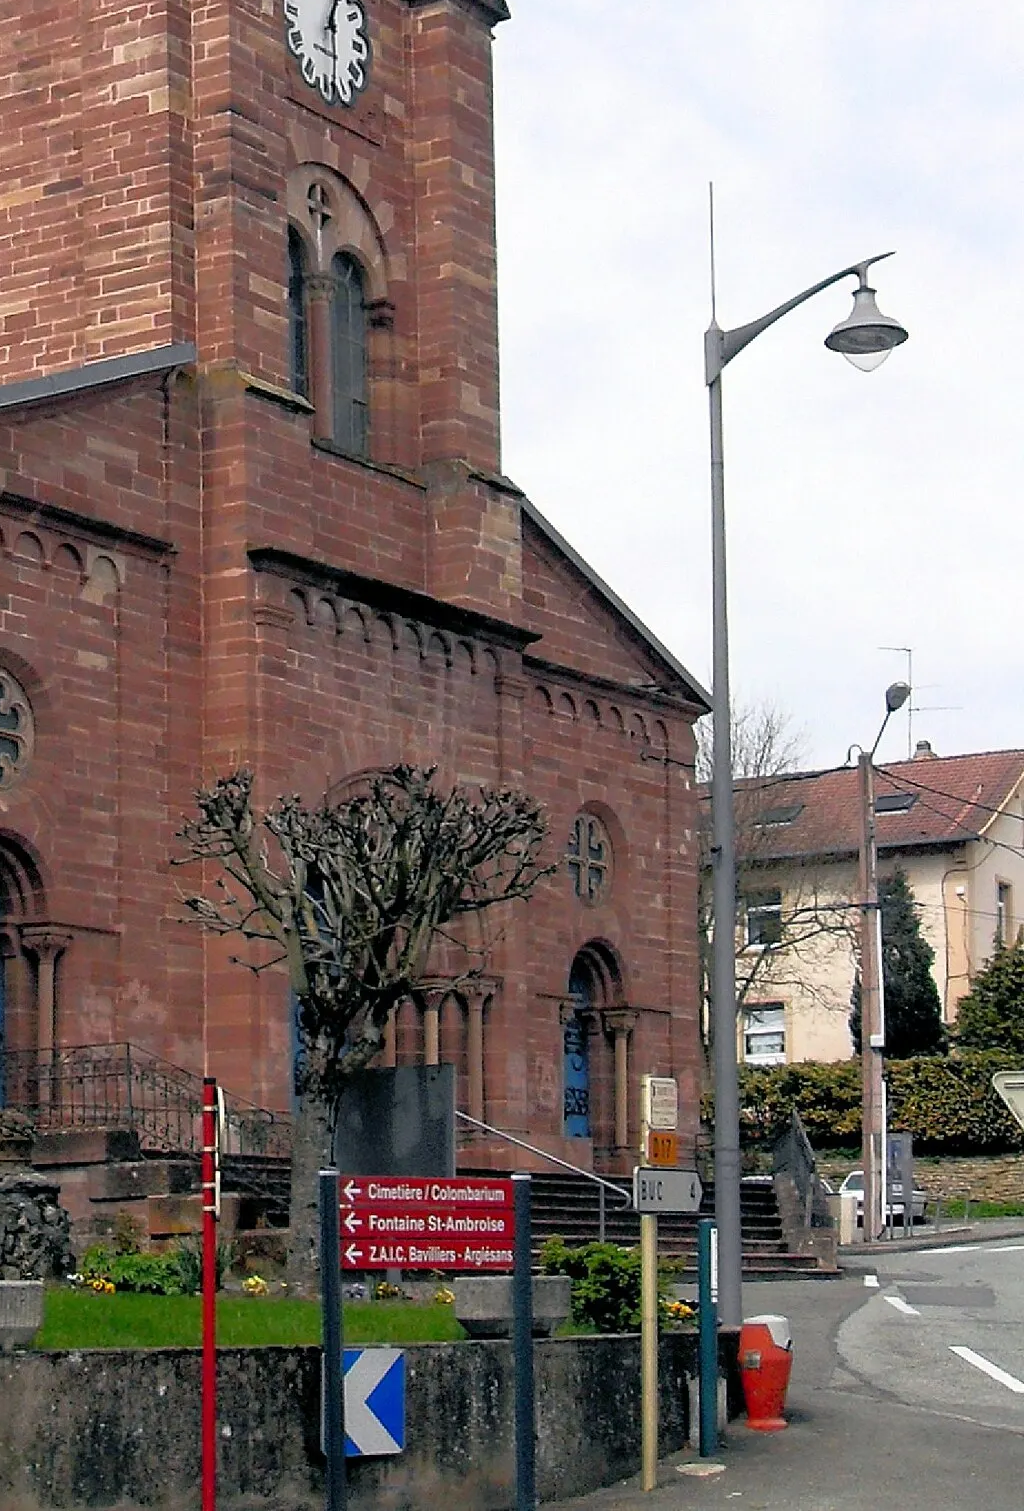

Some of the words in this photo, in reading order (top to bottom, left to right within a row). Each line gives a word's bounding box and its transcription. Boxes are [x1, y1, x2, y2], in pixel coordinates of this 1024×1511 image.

[368, 1183, 423, 1200] Cimetière
[431, 1184, 505, 1201] Colombarium
[641, 1179, 663, 1201] BUC
[369, 1215, 425, 1231] Fontaine
[428, 1215, 505, 1232] St-Ambroise
[369, 1245, 407, 1262] Z.A.I.C.
[409, 1246, 456, 1262] Bavilliers
